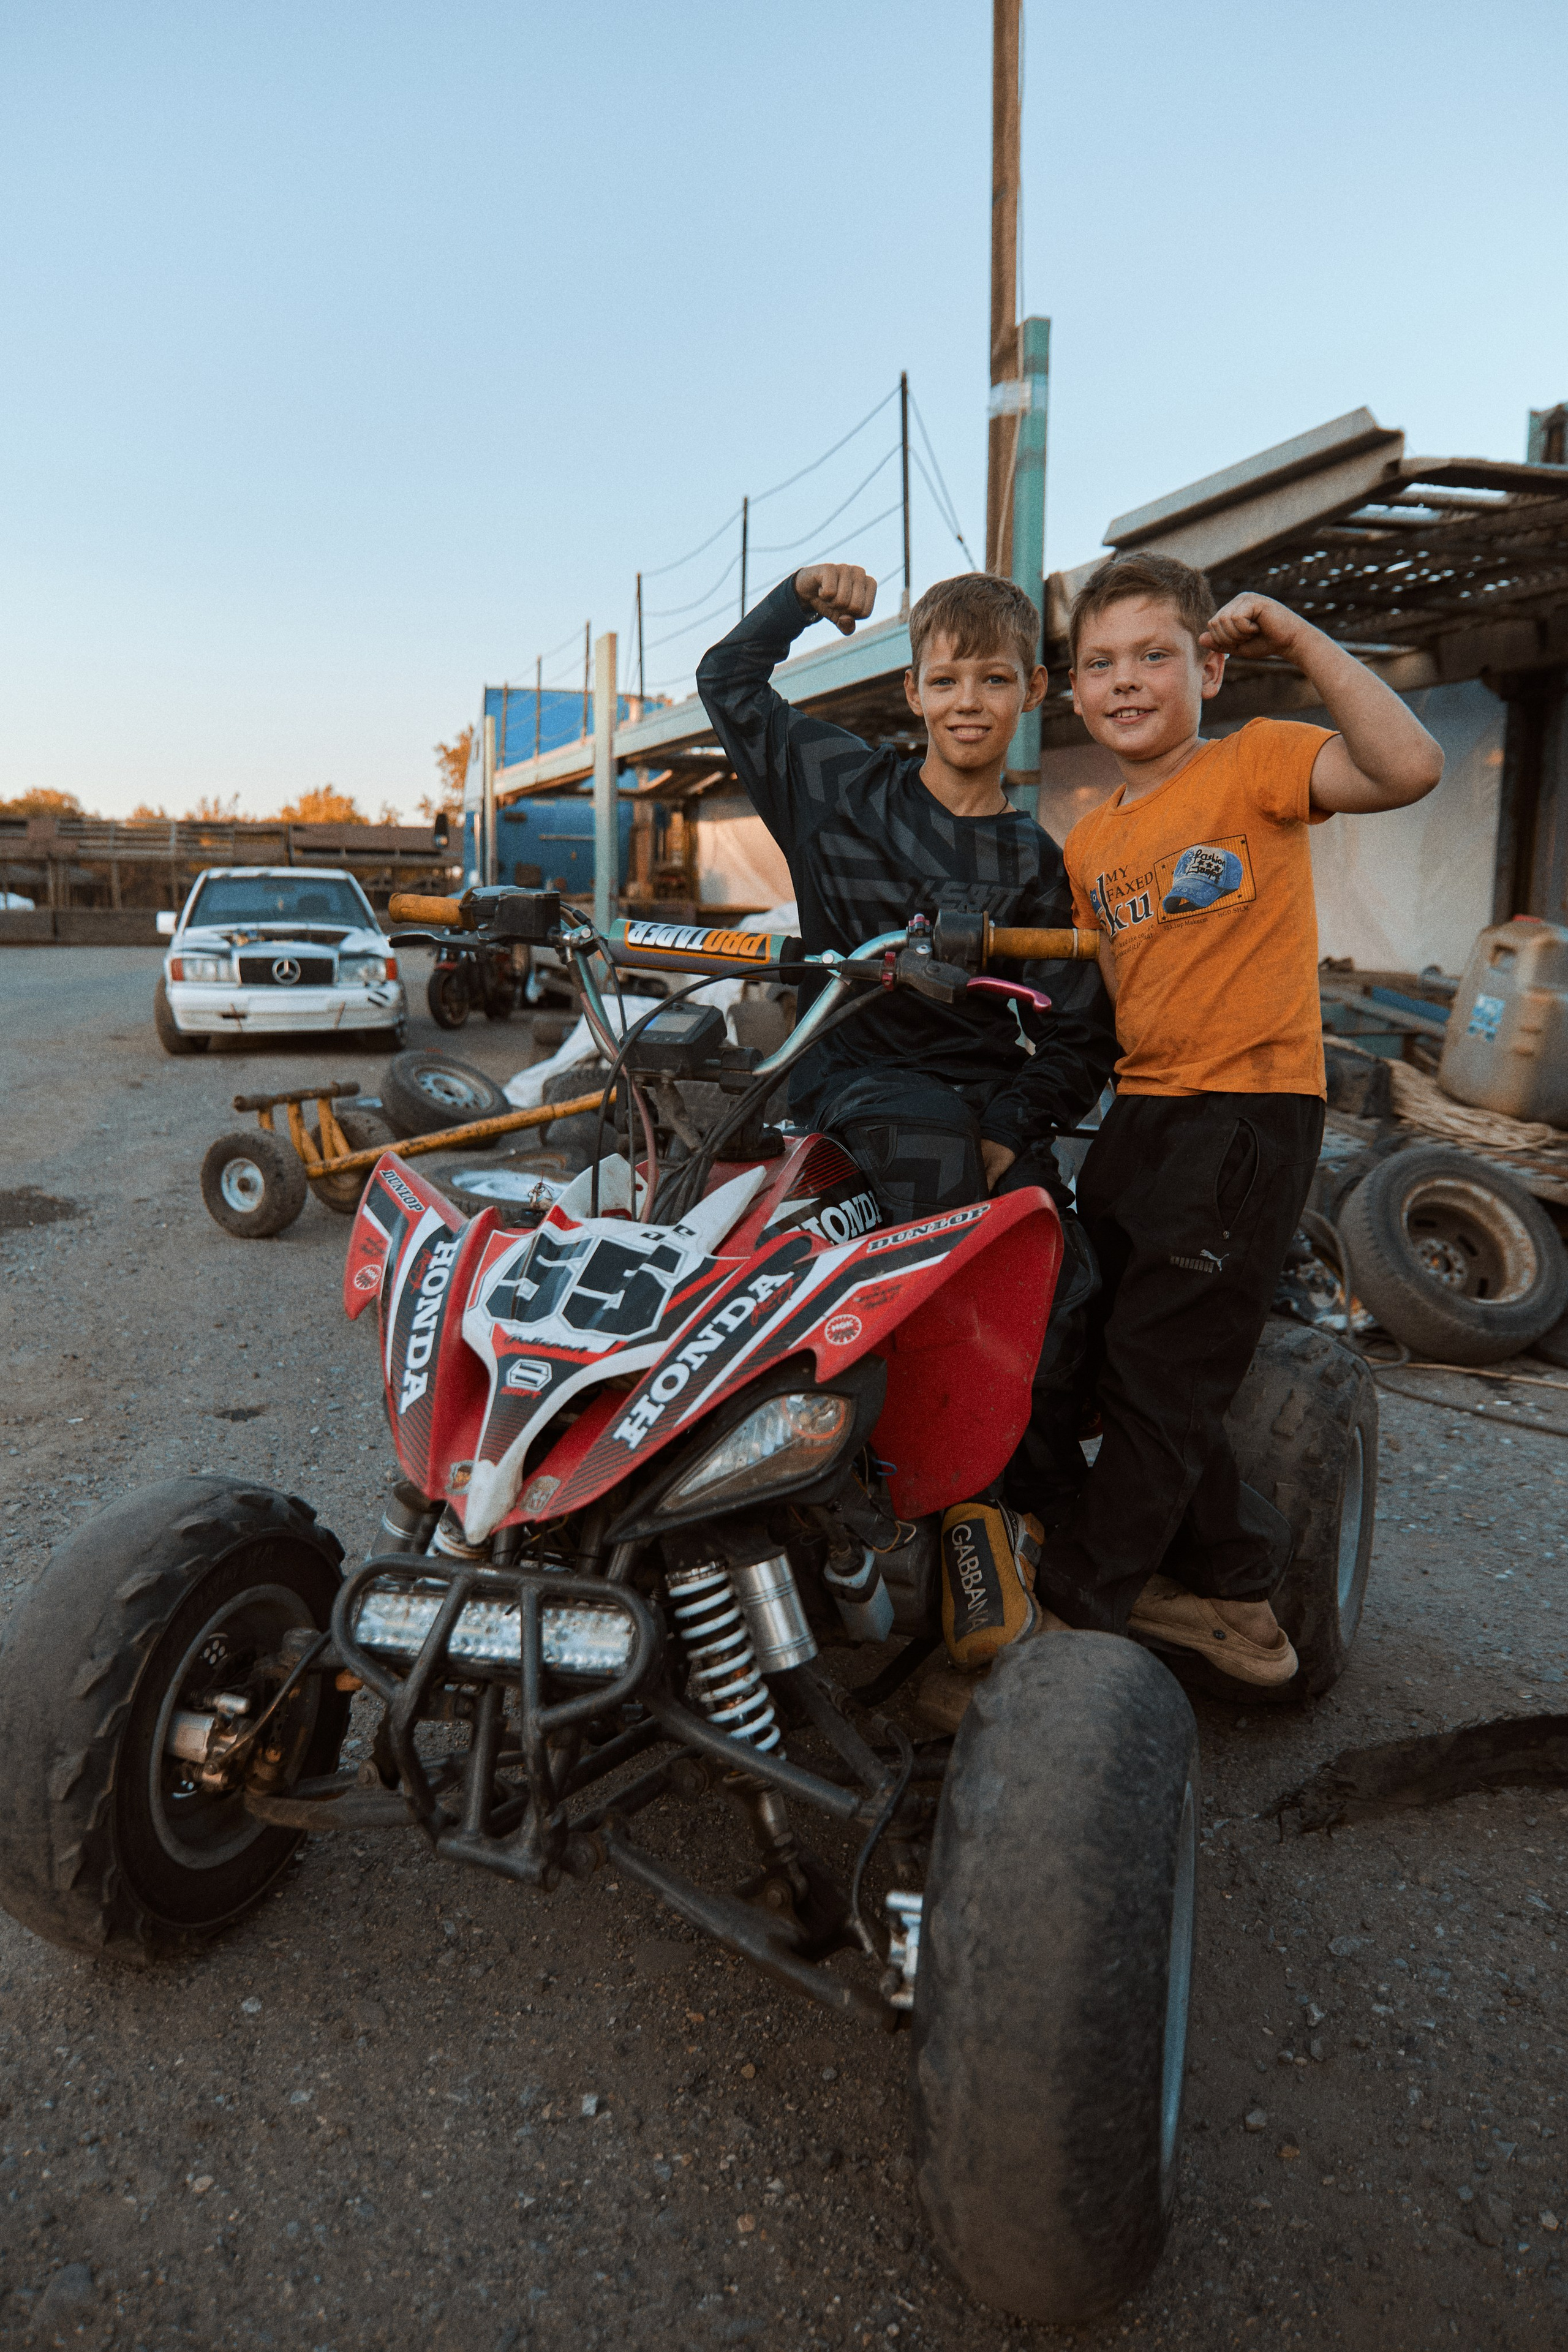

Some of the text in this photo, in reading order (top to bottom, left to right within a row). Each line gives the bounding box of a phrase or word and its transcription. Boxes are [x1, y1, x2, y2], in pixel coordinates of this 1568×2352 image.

[1106, 865, 1128, 886] MY
[1106, 871, 1154, 902] FAXED
[379, 1169, 426, 1212] DUNLOP
[867, 1204, 991, 1253] DUNLOP
[399, 1238, 461, 1415] HONDA
[613, 1272, 795, 1450] HONDA
[951, 1523, 989, 1634] GABBANA
